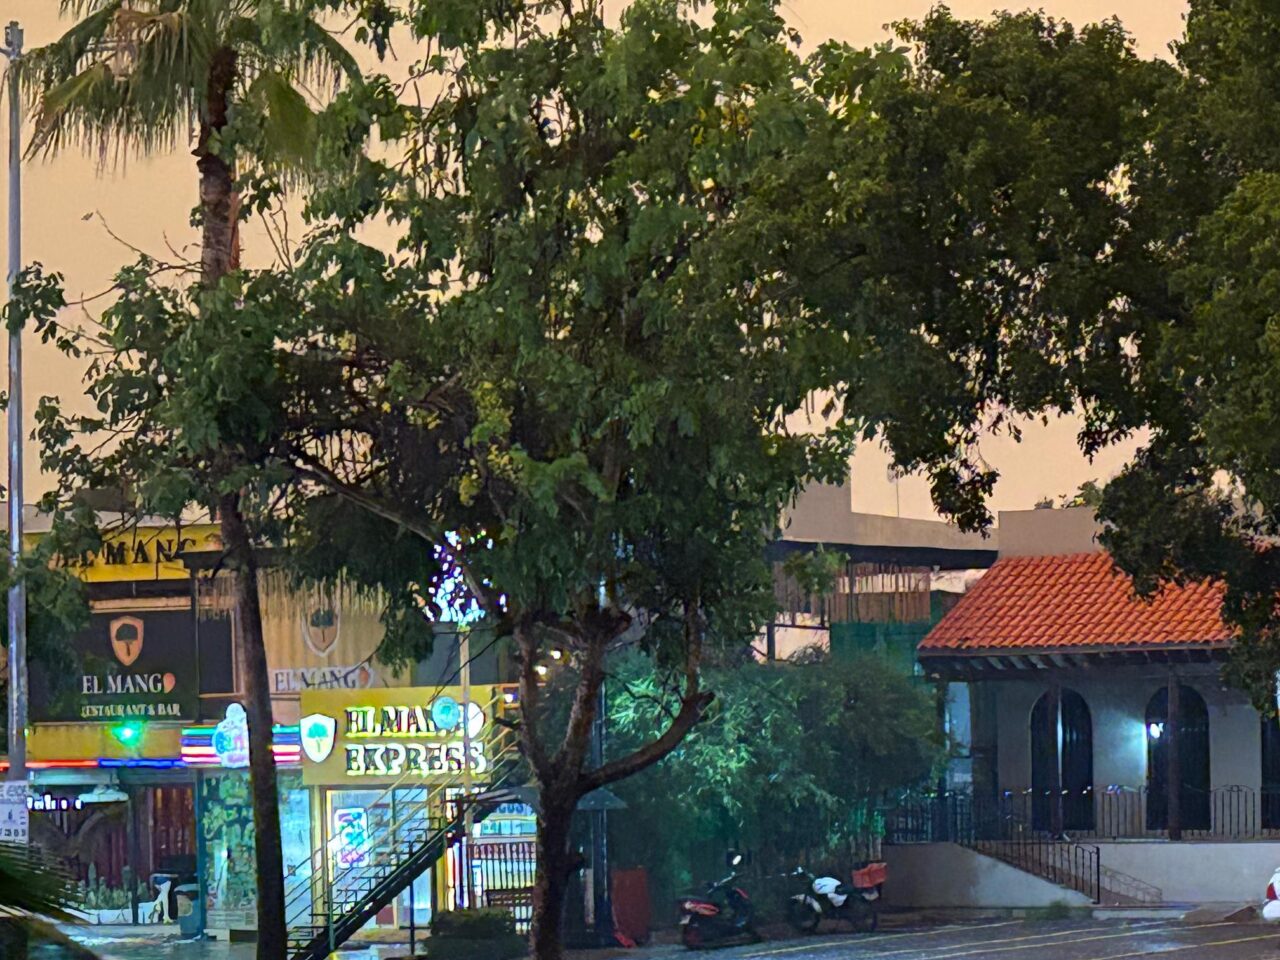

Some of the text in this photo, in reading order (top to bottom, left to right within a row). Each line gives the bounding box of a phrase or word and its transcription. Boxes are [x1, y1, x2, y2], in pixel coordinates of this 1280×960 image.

[81, 675, 103, 694] EL
[275, 670, 296, 692] EL
[81, 704, 146, 717] RESTAURANT
[157, 703, 181, 716] BAR
[345, 706, 382, 738] EL
[345, 741, 487, 777] EXPRESS
